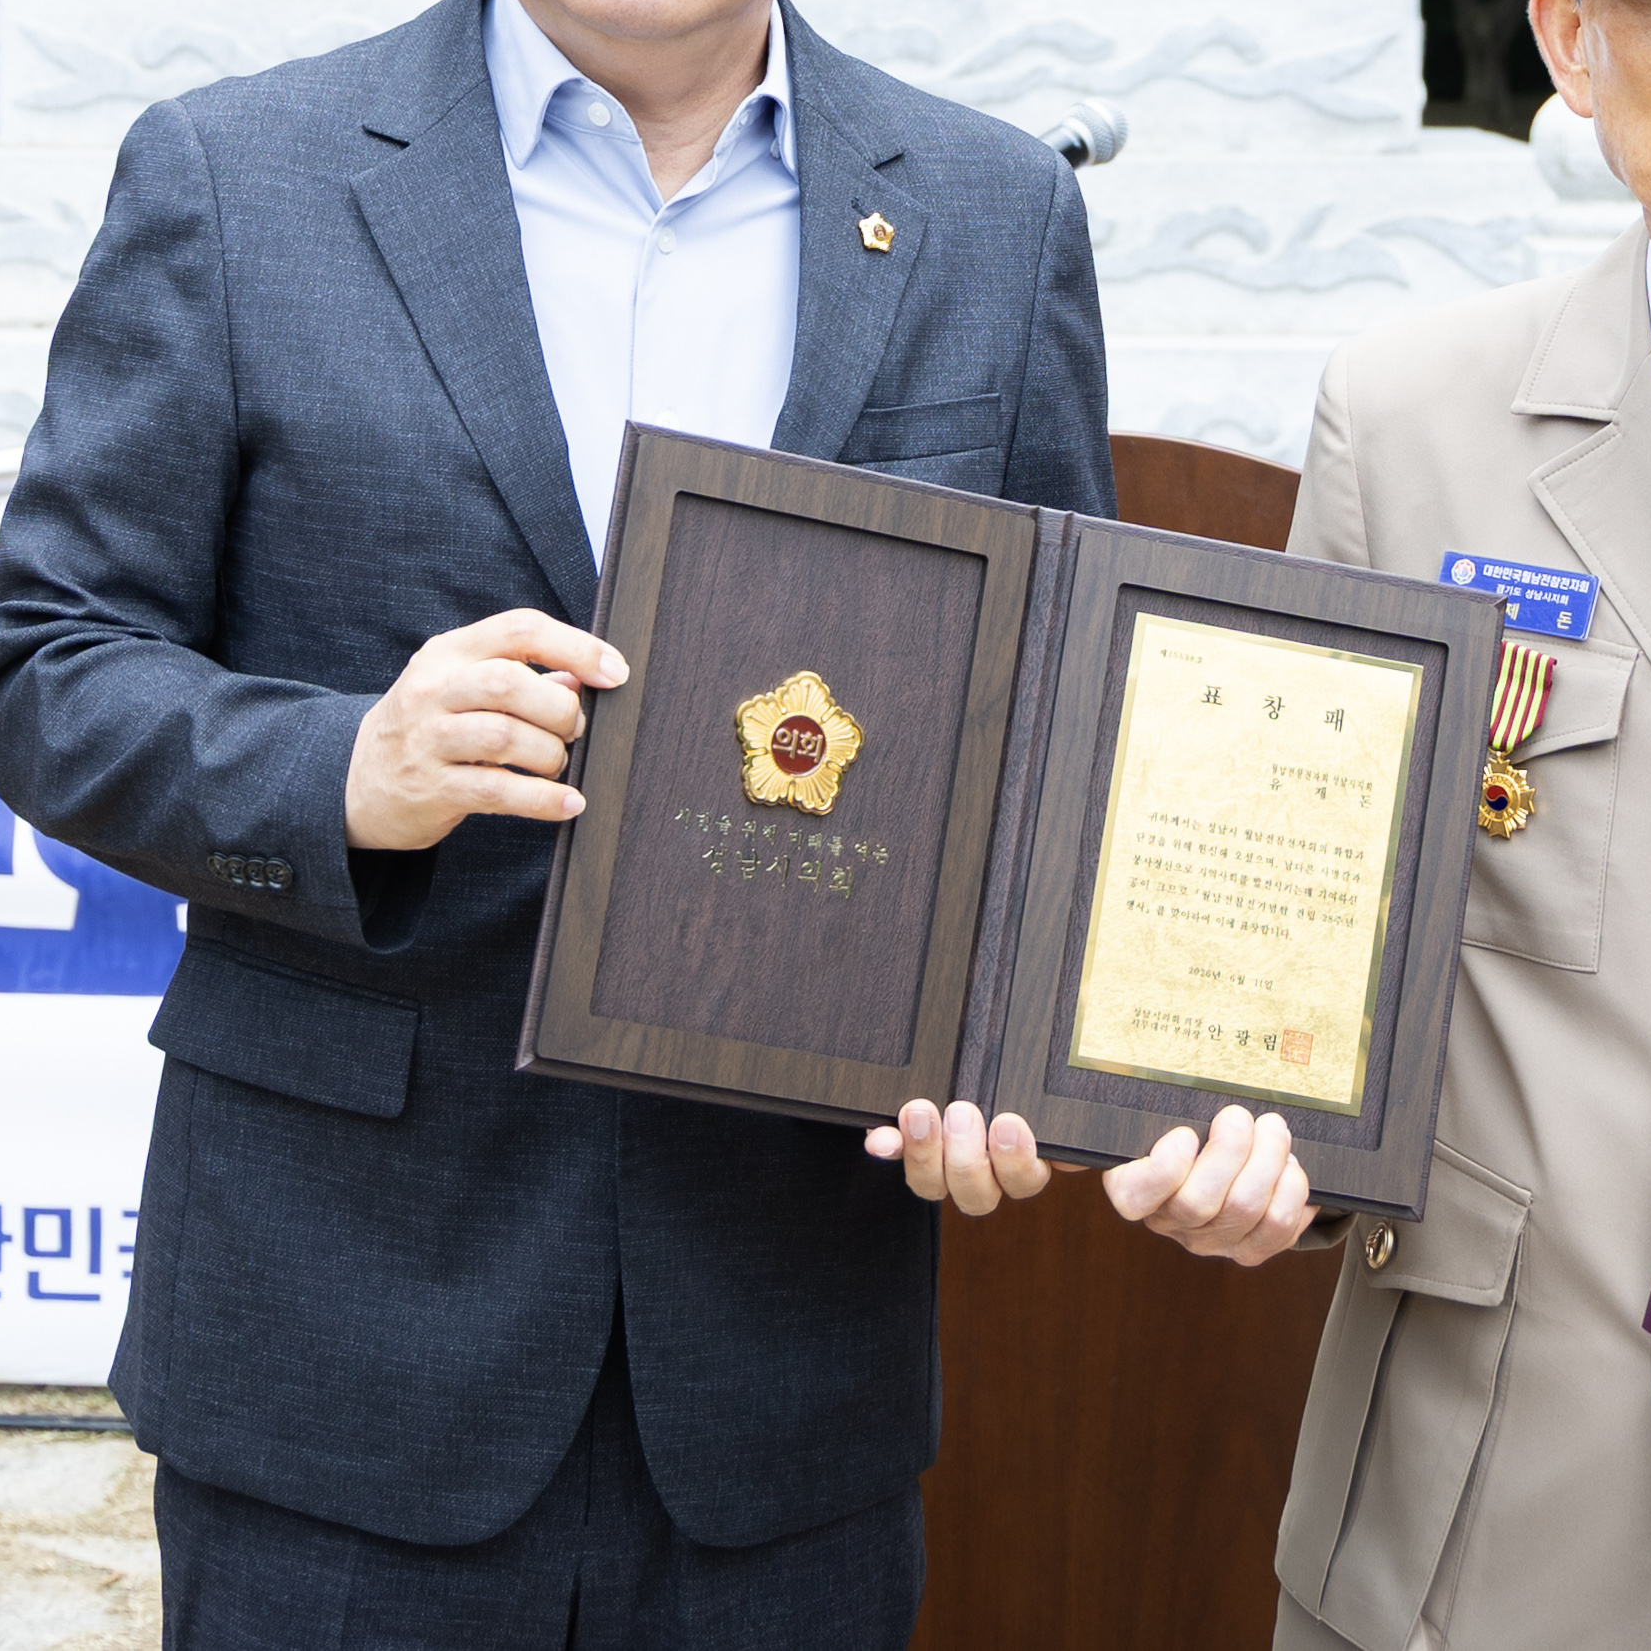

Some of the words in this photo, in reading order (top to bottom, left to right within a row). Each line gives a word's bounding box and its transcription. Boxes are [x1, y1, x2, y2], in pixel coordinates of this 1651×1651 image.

[1482, 563, 1590, 594] 대한민국월남전참전자회
[1495, 583, 1522, 598] 경기도
[1525, 589, 1570, 606] 성남시지회
[1556, 611, 1573, 630] 돈
[772, 727, 824, 764] 의회
[788, 829, 844, 857] 미래를
[1208, 822, 1238, 838] 성남시
[701, 842, 853, 899] 성남시의회
